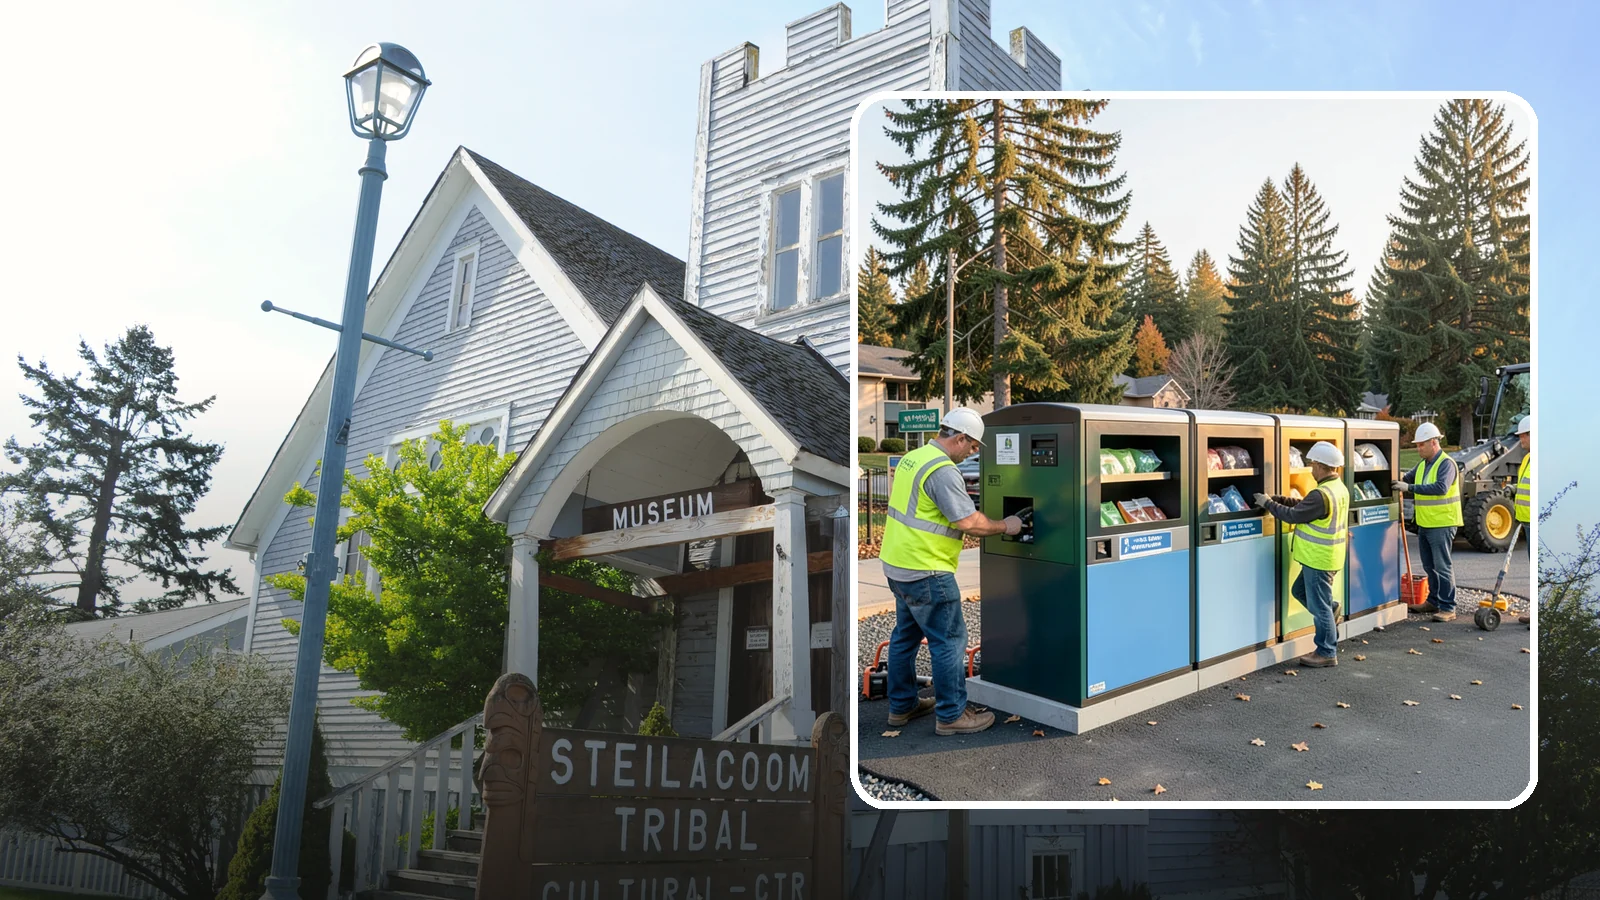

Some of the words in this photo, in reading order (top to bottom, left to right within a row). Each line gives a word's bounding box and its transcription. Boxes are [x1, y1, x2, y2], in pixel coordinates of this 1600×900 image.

[613, 492, 713, 531] MUSEUM
[550, 738, 809, 792] STEILACOOM
[615, 806, 757, 851] TRIBAL
